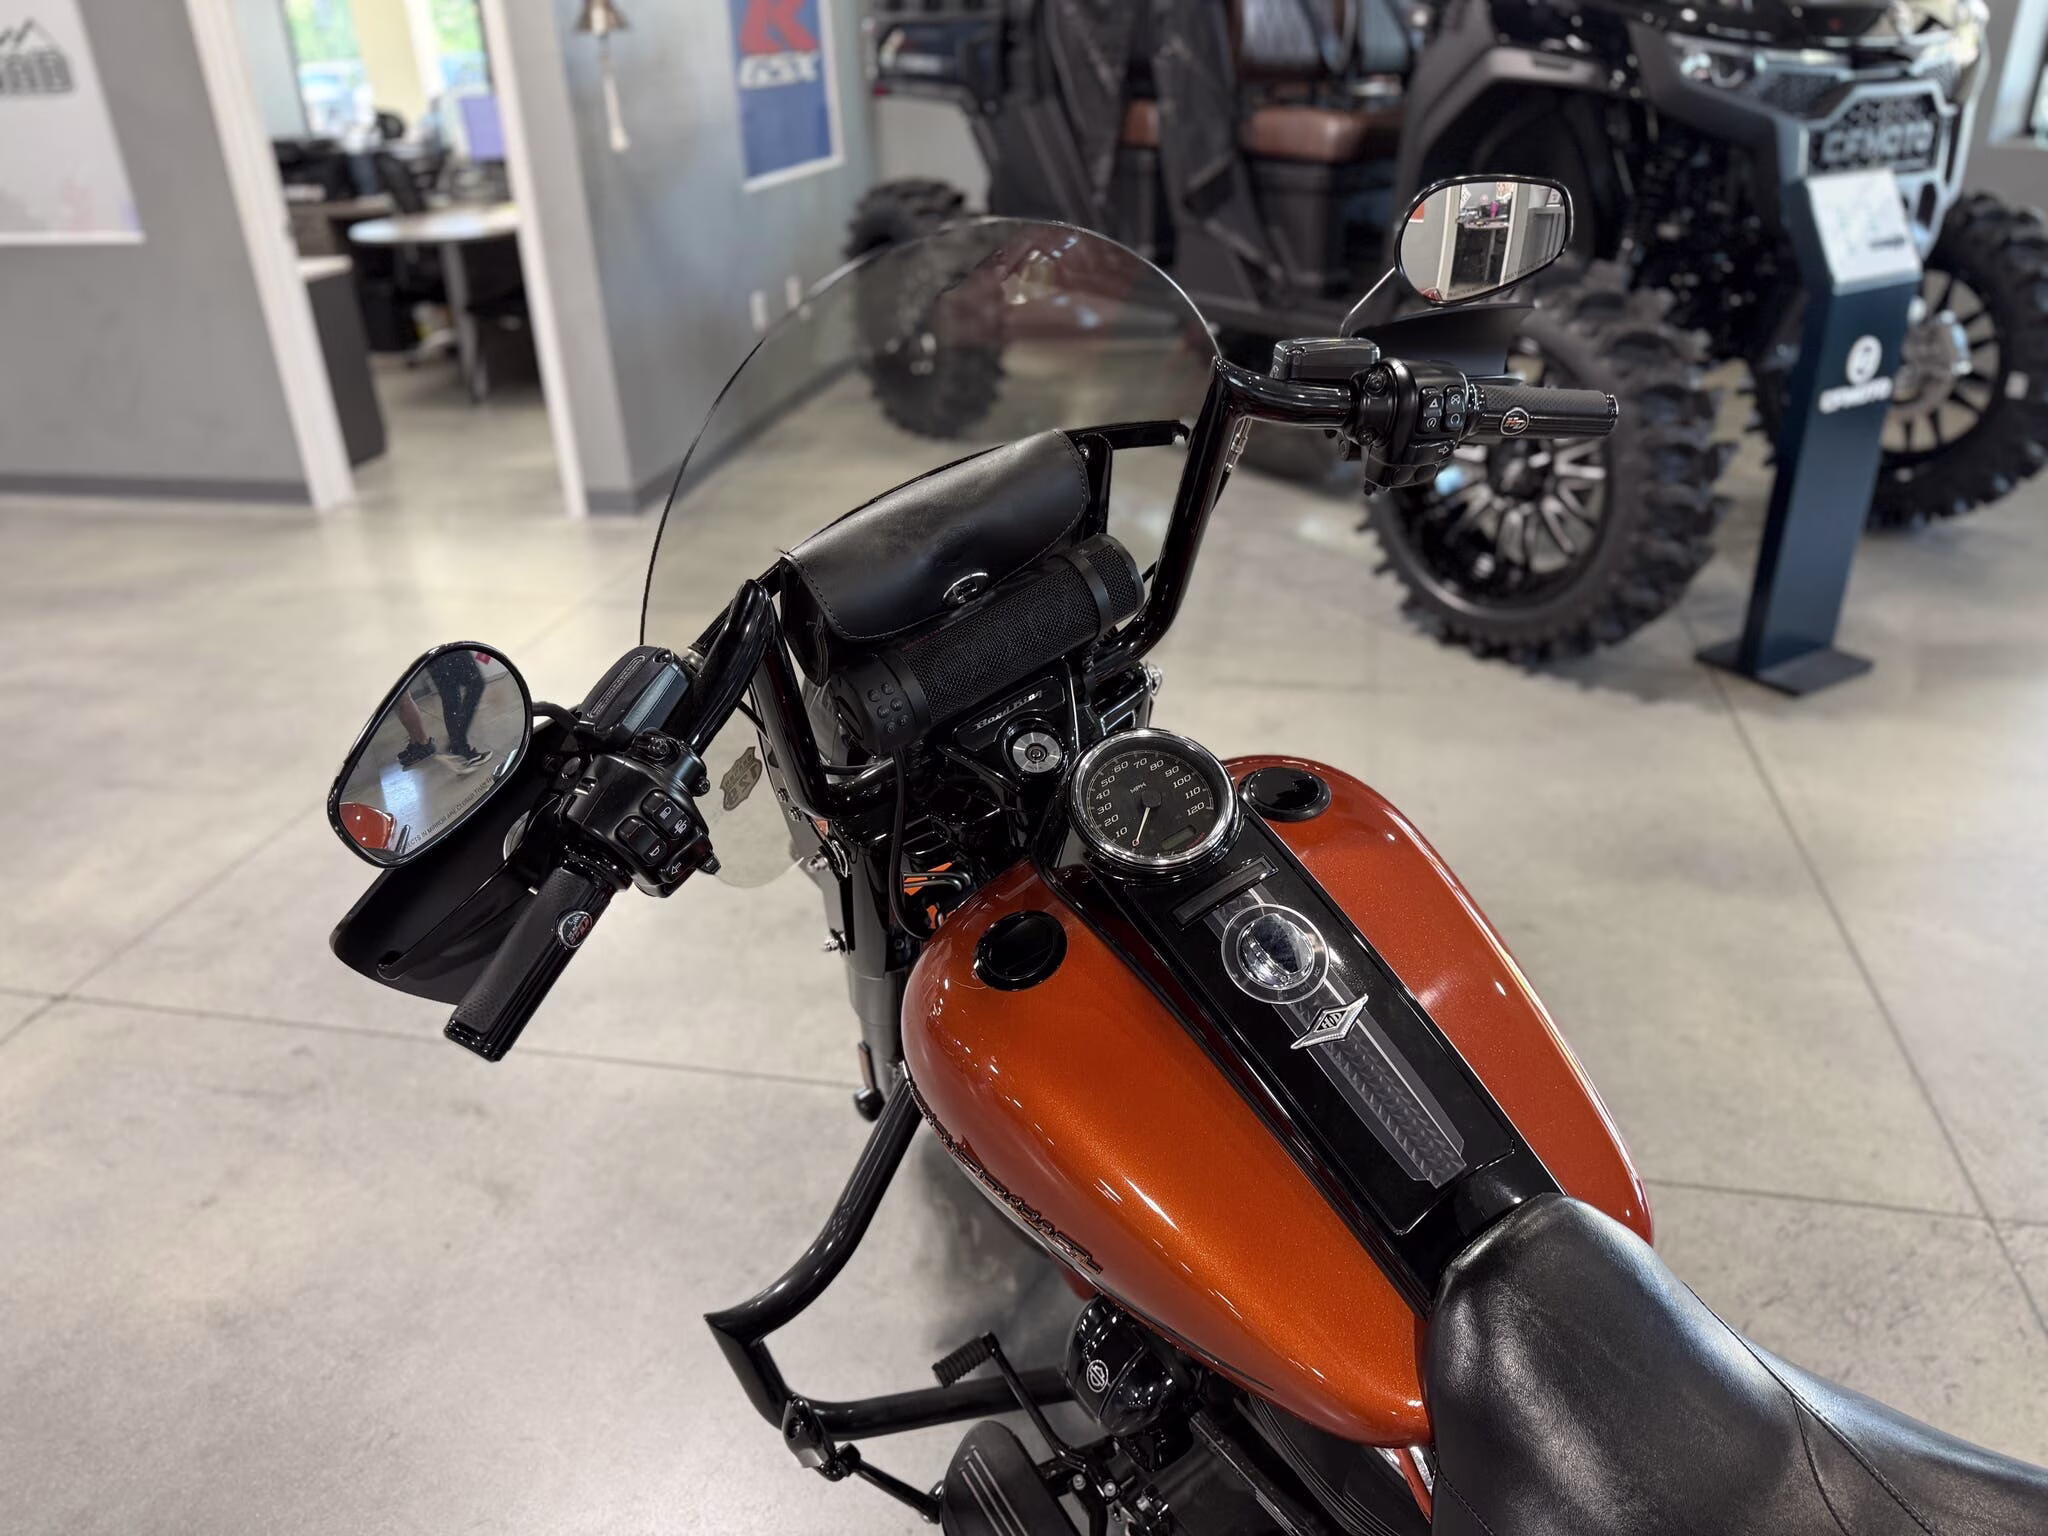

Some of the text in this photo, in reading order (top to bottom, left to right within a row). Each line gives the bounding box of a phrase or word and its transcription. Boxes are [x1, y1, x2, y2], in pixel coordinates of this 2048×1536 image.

[1113, 761, 1129, 773] 60
[1133, 757, 1148, 769] 70
[1149, 759, 1164, 771] 80
[1164, 765, 1180, 778] 90
[1100, 775, 1116, 788] 50
[1129, 781, 1147, 794] MPH
[1172, 774, 1192, 789] 100
[1095, 789, 1111, 801] 40
[1185, 786, 1201, 799] 110
[1097, 802, 1112, 815] 30
[1186, 801, 1205, 817] 120
[1103, 814, 1119, 827] 20
[1115, 826, 1128, 839] 10
